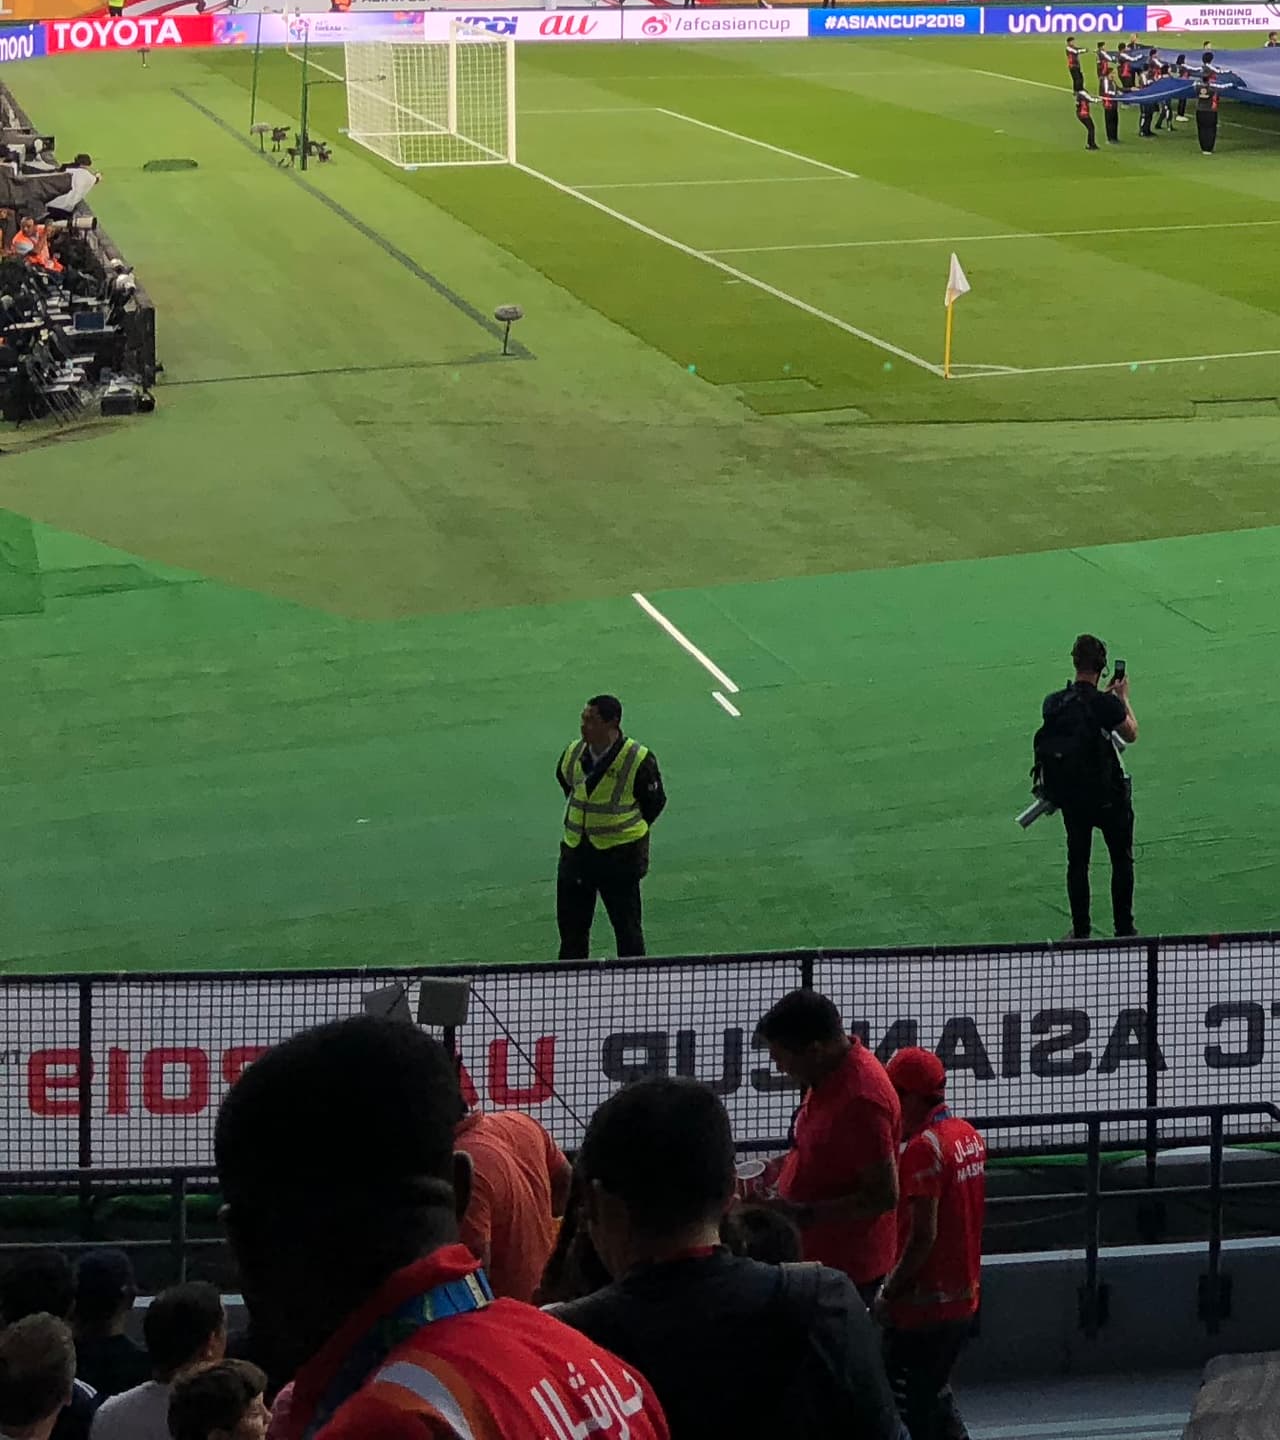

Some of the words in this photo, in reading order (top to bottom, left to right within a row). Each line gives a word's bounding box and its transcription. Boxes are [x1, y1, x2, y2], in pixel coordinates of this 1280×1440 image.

[539, 15, 598, 35] au
[824, 15, 965, 30] #ASIANCUP2019
[1184, 17, 1211, 26] ASIA
[1214, 17, 1269, 26] TOGETHER
[54, 19, 182, 49] TOYOTA
